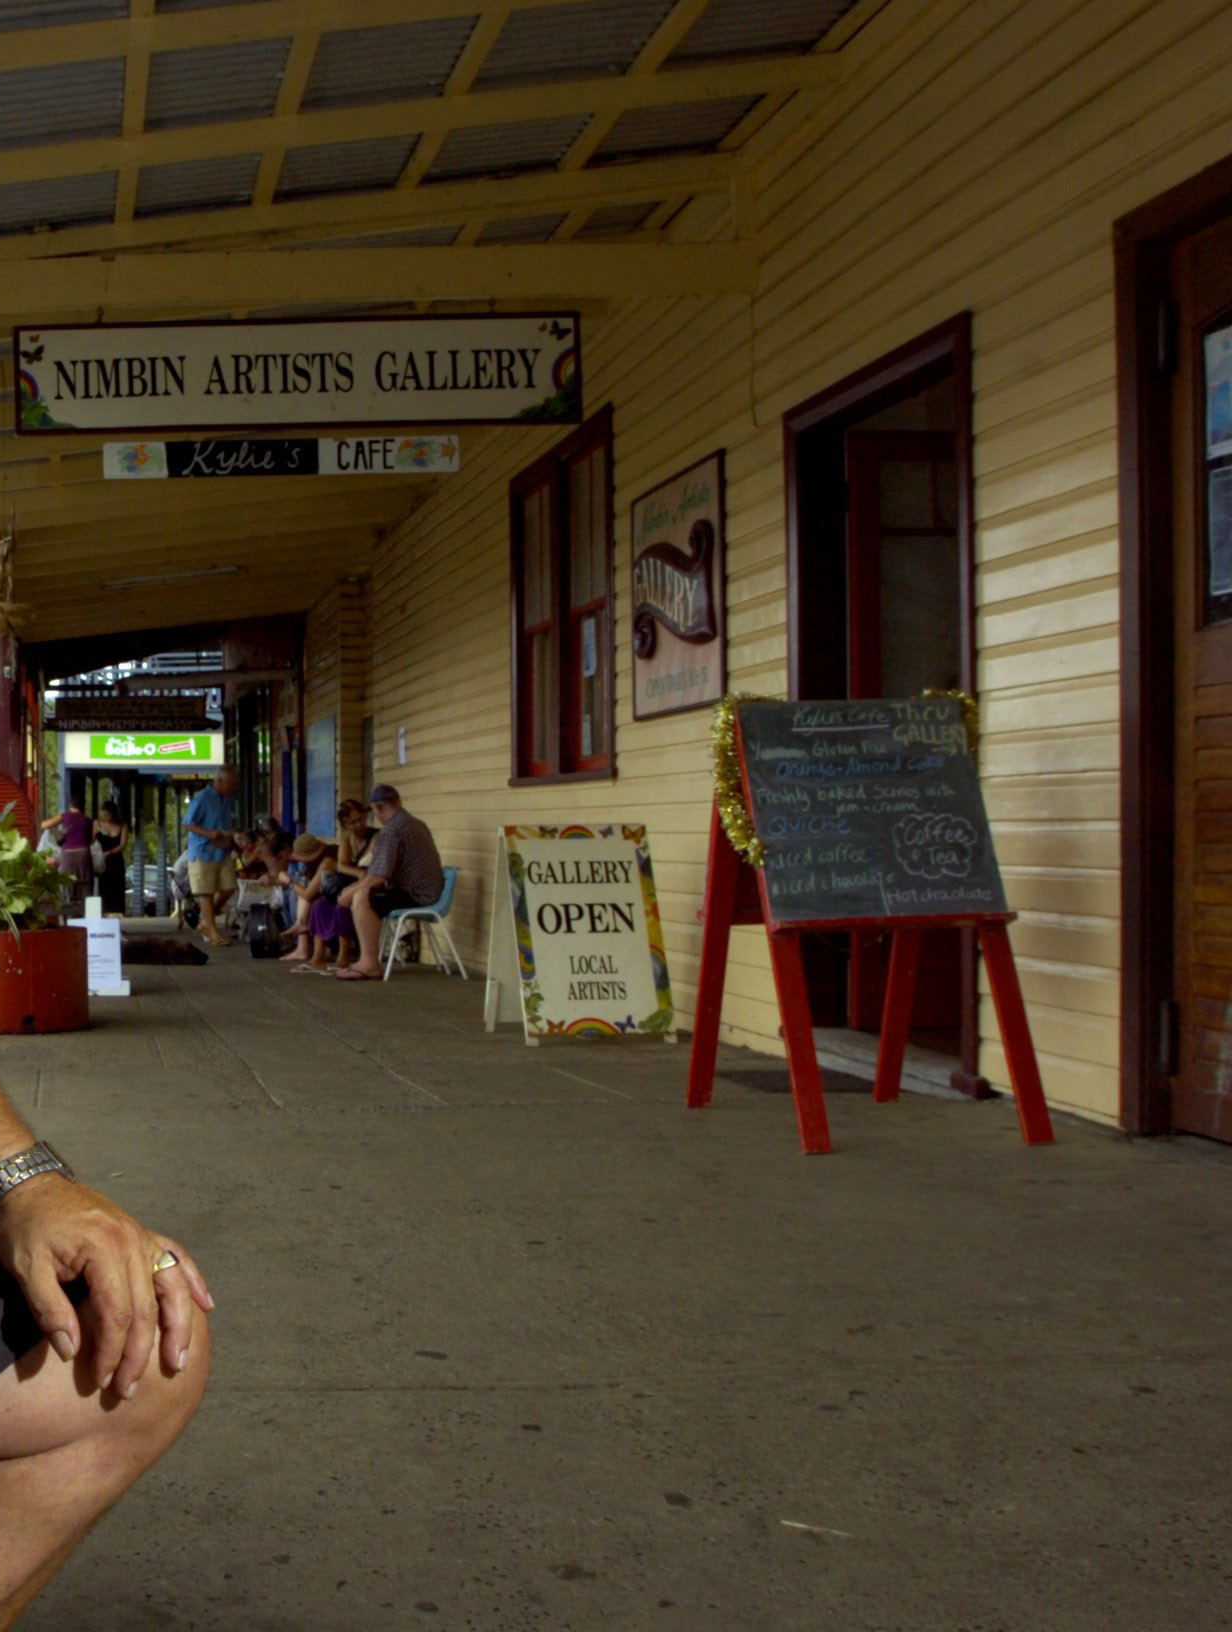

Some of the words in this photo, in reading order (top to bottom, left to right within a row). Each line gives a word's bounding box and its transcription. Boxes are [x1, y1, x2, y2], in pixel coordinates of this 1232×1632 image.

[53, 354, 187, 400] NIMBIN
[204, 351, 355, 396] ARTISTS
[374, 347, 542, 393] GALLERY
[182, 440, 301, 476] Kylie's
[337, 438, 395, 471] CAFE
[634, 556, 698, 632] GALLERY
[889, 703, 950, 721] Thru
[58, 718, 100, 729] NIMBIN
[816, 783, 866, 801] baked
[903, 818, 968, 846] Coffee
[926, 847, 960, 865] Tea
[527, 860, 633, 885] GALLERY
[536, 902, 636, 935] OPEN
[569, 955, 618, 975] LOCAL
[567, 981, 627, 1001] ARTISTS
